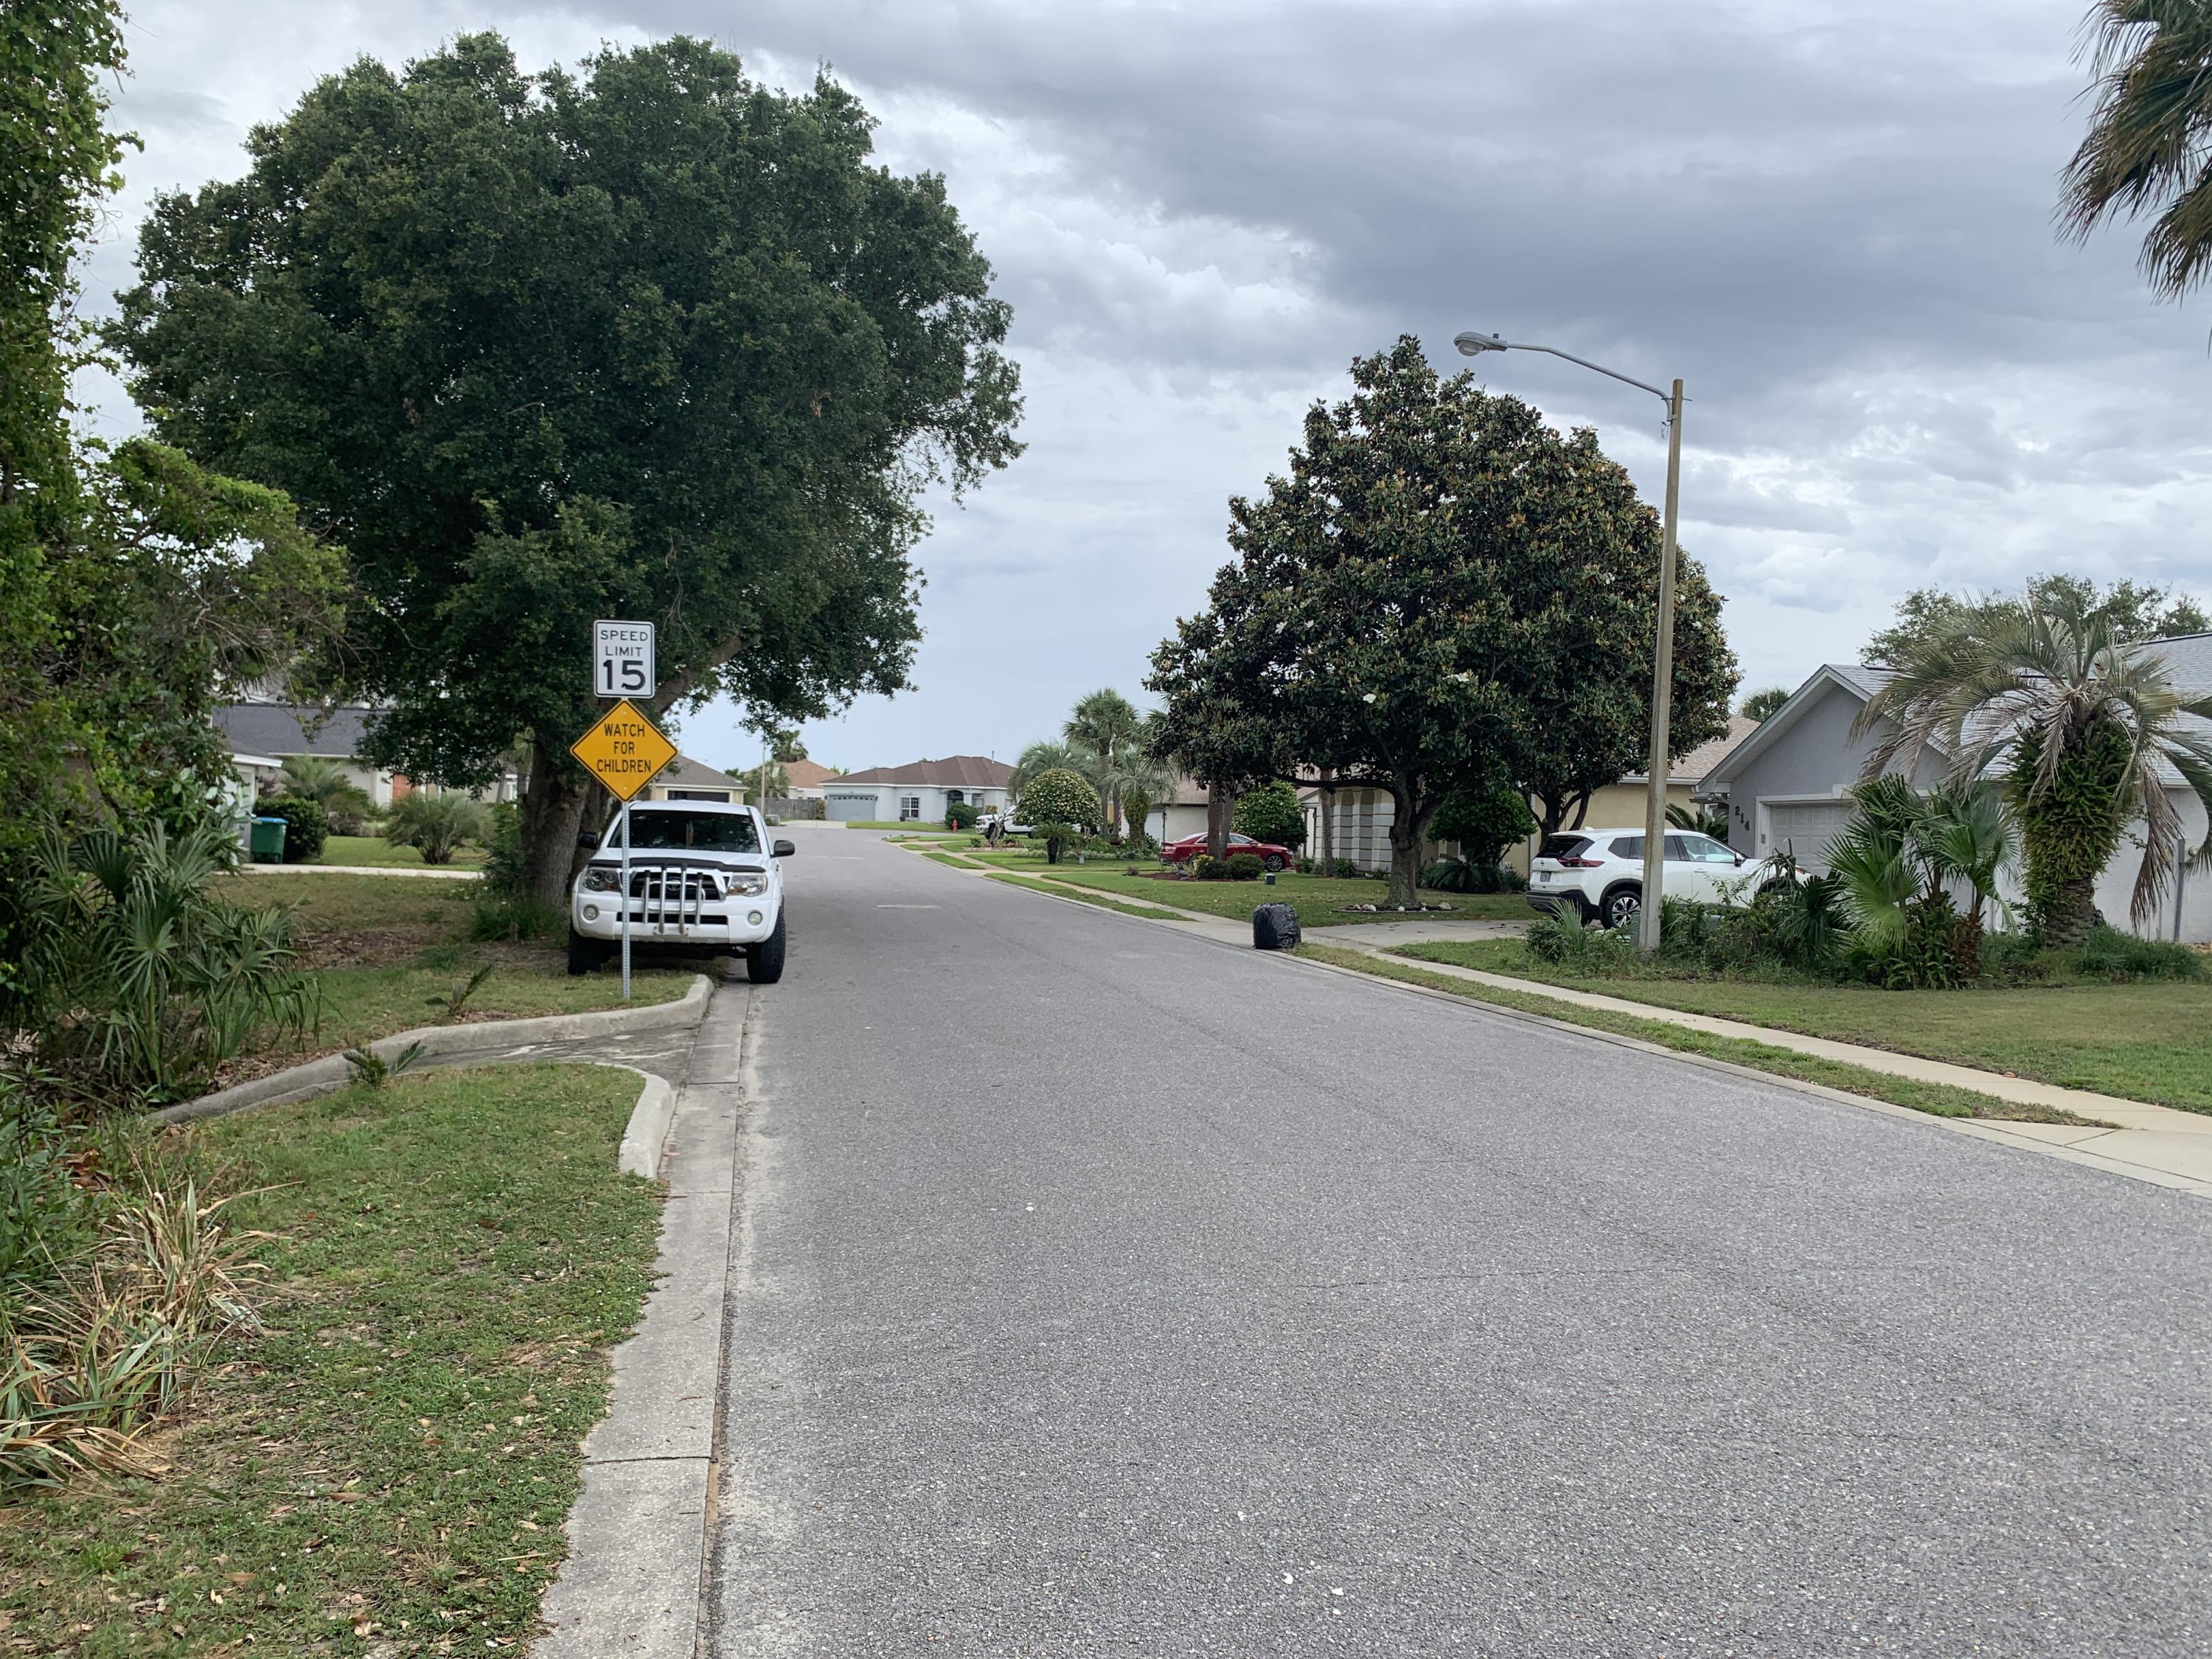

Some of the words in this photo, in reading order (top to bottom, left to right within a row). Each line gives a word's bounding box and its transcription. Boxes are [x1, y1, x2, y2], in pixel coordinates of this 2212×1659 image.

[600, 630, 648, 641] SPEED
[605, 646, 642, 657] LIMIT
[603, 659, 646, 691] 15
[605, 723, 644, 737] WATCH
[613, 741, 635, 755] FOR
[597, 759, 651, 773] CHILDREN
[1734, 805, 1750, 831] 214
